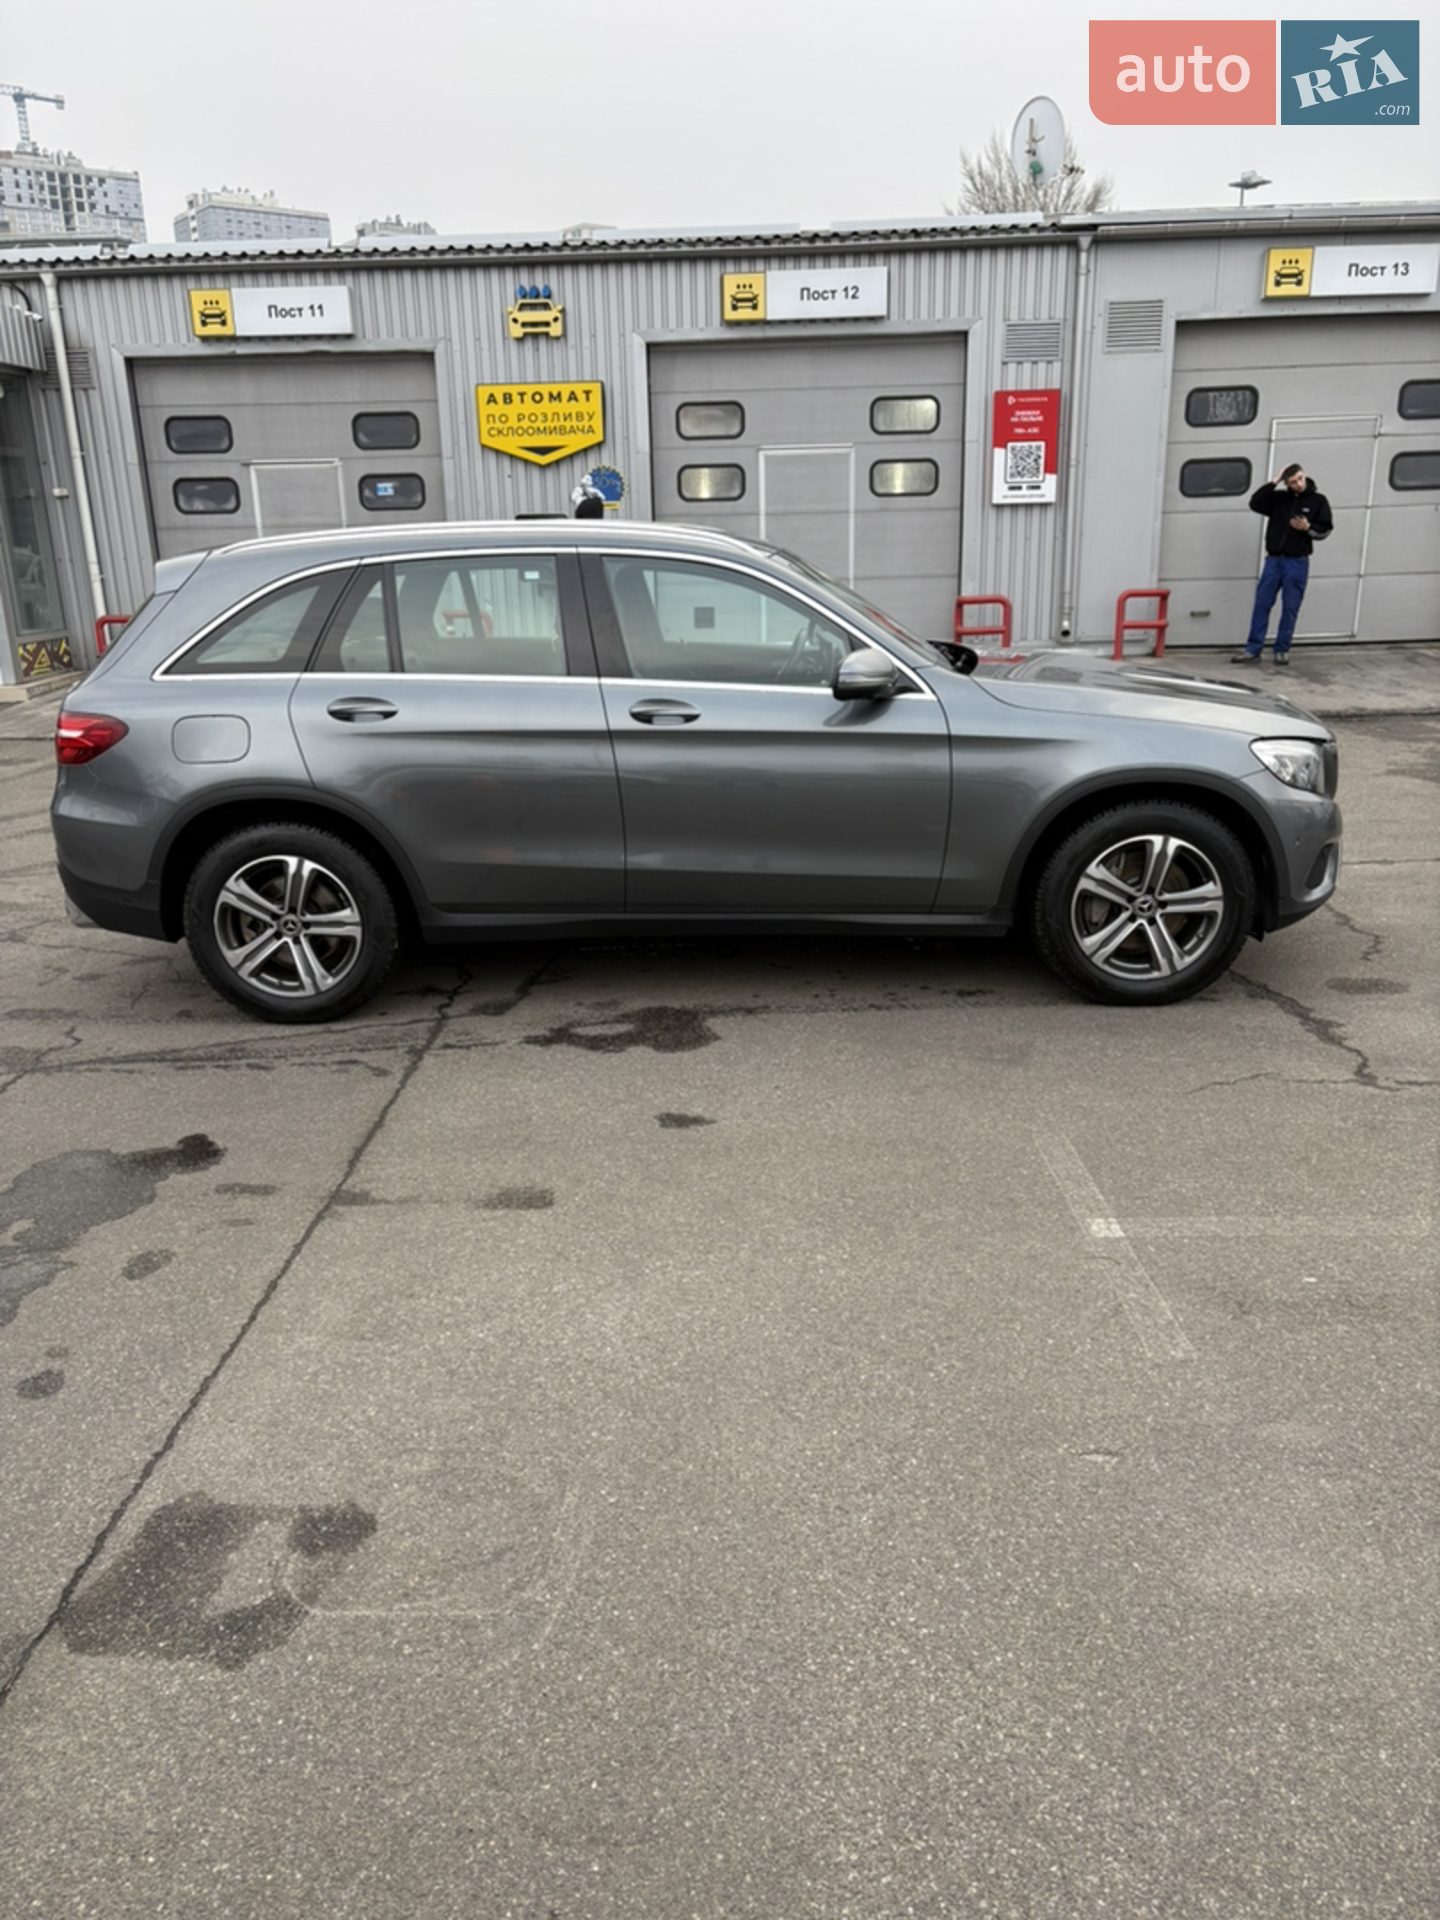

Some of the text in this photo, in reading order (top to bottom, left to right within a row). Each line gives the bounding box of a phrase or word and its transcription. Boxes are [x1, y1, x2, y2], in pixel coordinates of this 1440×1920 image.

[1347, 262, 1410, 277] Пост 13
[800, 285, 860, 301] Пост 12
[267, 304, 324, 318] Пост 11
[486, 390, 593, 405] АВТОМАТ
[486, 411, 595, 424] ПО РОЗЛИВУ
[487, 424, 596, 438] СКЛООМИВАЧА
